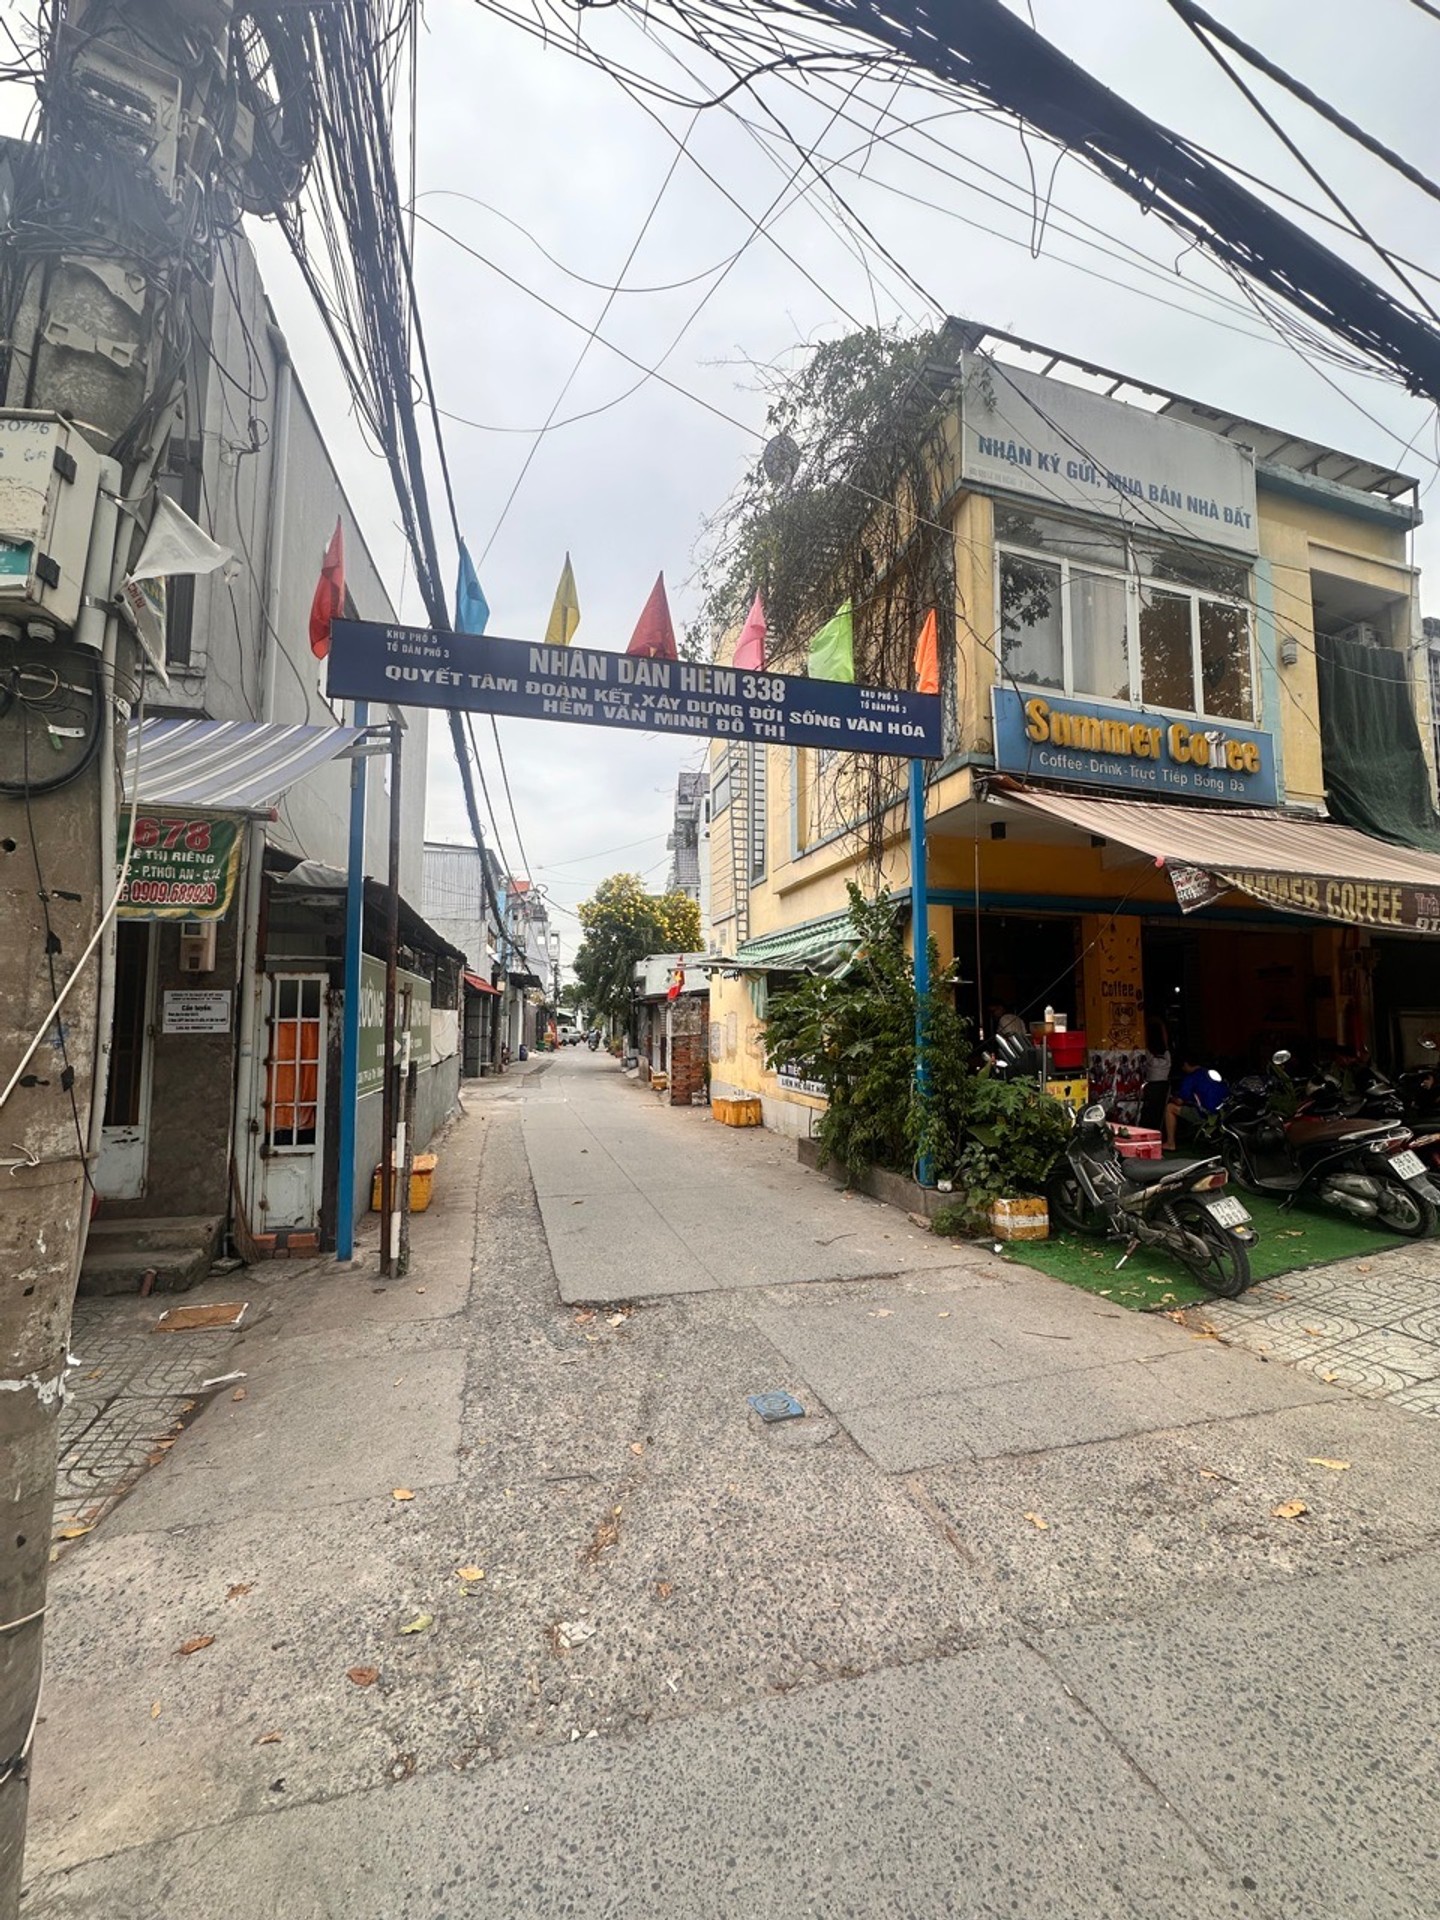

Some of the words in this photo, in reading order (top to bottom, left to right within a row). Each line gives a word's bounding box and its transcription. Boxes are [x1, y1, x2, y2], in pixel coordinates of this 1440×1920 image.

[978, 435, 1032, 467] NHẬN
[1037, 452, 1061, 474] KÝ
[1066, 458, 1101, 488] GỬI,
[1106, 470, 1144, 498] MUA
[1148, 484, 1183, 510] BÁN
[1186, 495, 1219, 520] NHÀ
[1223, 505, 1251, 530] ĐẤT
[386, 629, 406, 642] KHU
[409, 631, 429, 644] PHỐ
[431, 634, 438, 644] 5
[402, 643, 422, 656] DÂN
[444, 650, 450, 659] 3
[529, 647, 607, 682] NHÂN
[617, 658, 671, 689] DÂN
[742, 674, 786, 703] 338
[385, 665, 463, 687] QUYẾT
[468, 672, 518, 693] TÂM
[525, 680, 587, 700] ĐOÀN
[642, 693, 681, 711] XÂY
[687, 699, 744, 717] DỰNG
[749, 704, 783, 723] ĐỜI
[789, 709, 841, 729] SỐNG
[846, 717, 883, 734] VĂN
[888, 720, 926, 738] HÓA
[543, 695, 594, 717] HẺM
[603, 702, 647, 723] VĂN
[654, 712, 709, 730] MINH
[716, 717, 745, 734] ĐÔ
[752, 721, 786, 741] THỊ
[1025, 697, 1163, 761] Summer
[1167, 721, 1262, 775] Coffee
[1162, 767, 1188, 787] Tiếp
[1193, 773, 1225, 793] Bóng
[133, 816, 212, 852] 678
[145, 850, 168, 863] THỊ
[172, 849, 215, 864] RIÊNG
[179, 868, 195, 880] AN
[1326, 880, 1403, 924] COFFEE
[1101, 980, 1135, 998] Coffee
